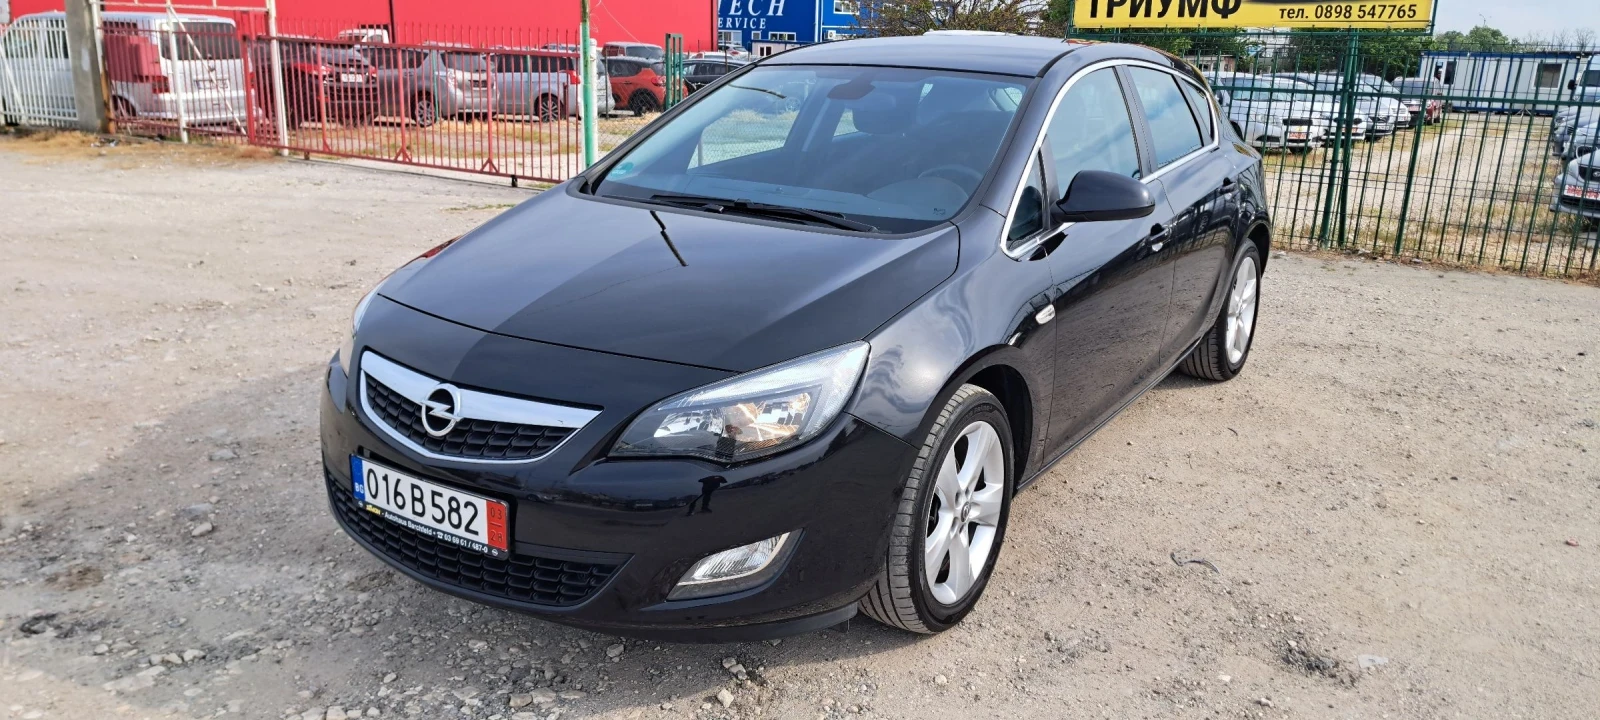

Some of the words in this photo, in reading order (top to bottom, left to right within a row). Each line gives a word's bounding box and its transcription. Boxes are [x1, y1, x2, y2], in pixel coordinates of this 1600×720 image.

[1279, 8, 1309, 19] тел.
[1315, 4, 1352, 19] 0898
[1357, 4, 1417, 19] 547765
[355, 482, 364, 493] BG
[384, 511, 407, 526] Autohaus
[491, 507, 502, 519] 03
